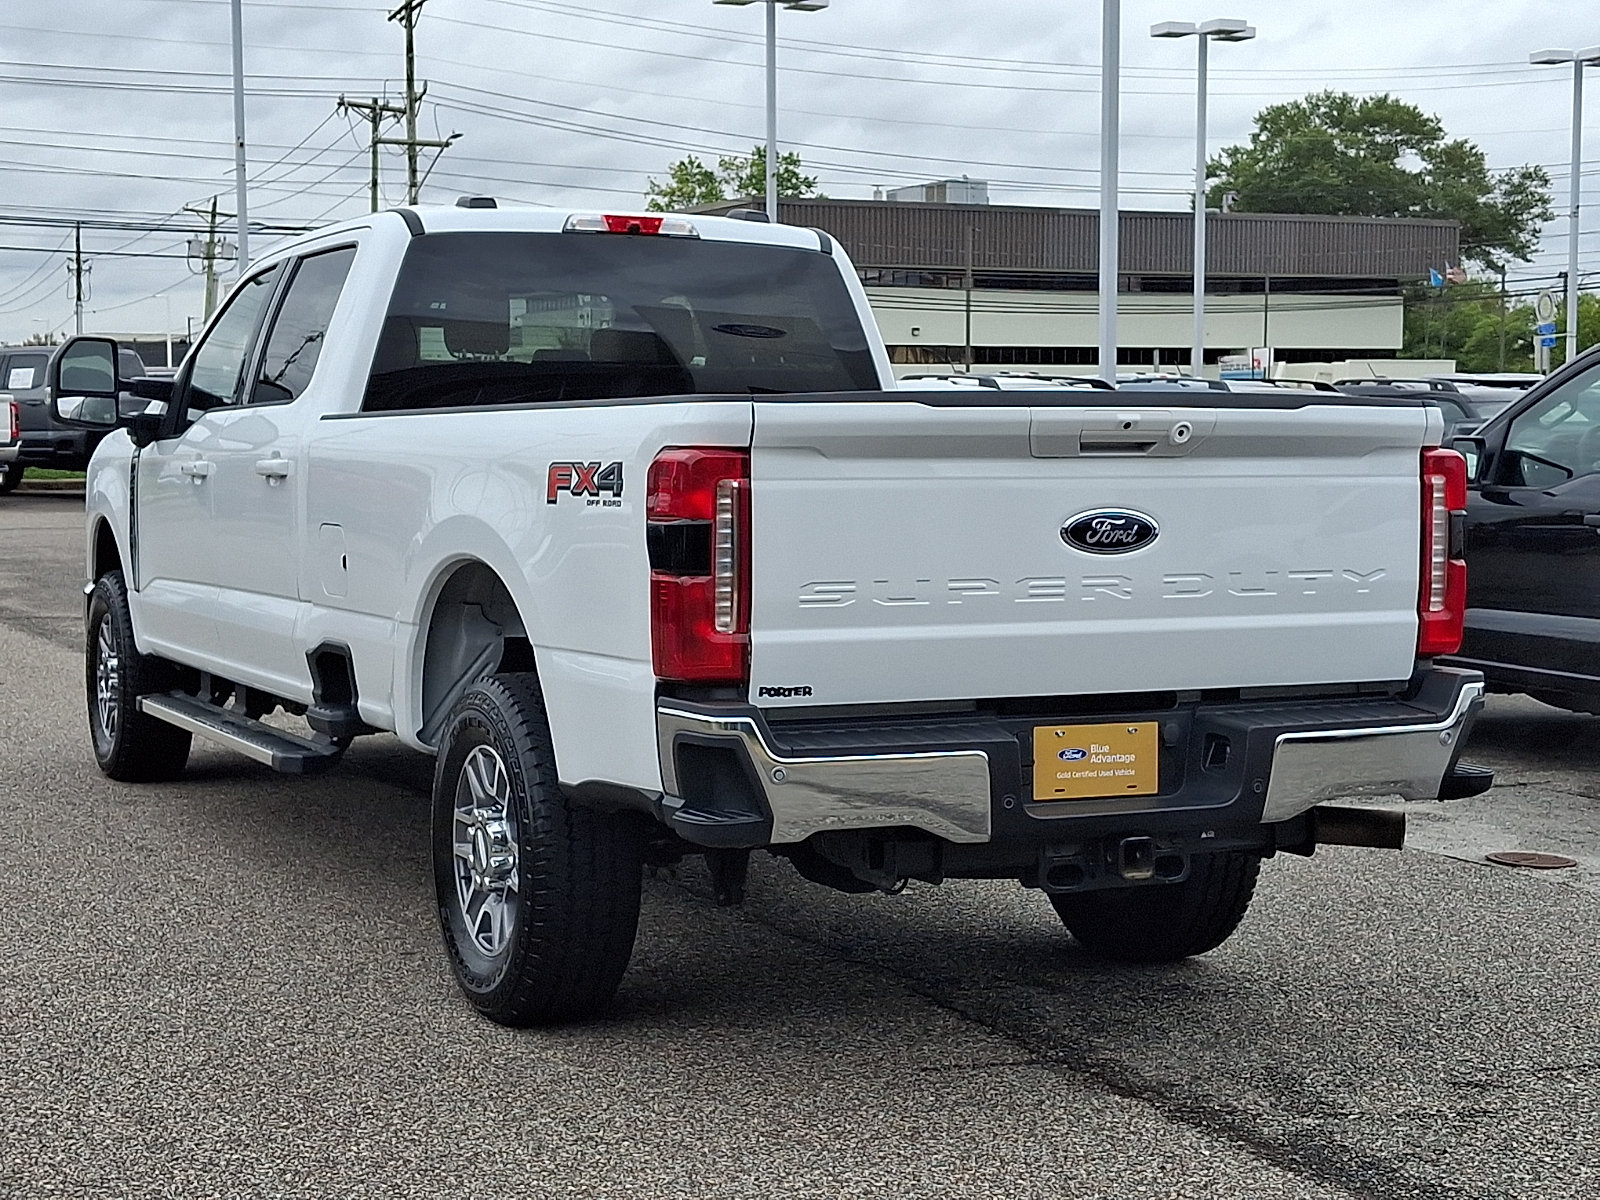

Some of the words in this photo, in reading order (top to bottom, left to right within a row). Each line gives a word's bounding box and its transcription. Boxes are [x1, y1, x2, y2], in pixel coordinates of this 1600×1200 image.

[546, 461, 624, 505] FX4
[586, 499, 600, 507] OFF
[602, 499, 622, 508] ROAD
[1085, 517, 1139, 544] Ford
[798, 574, 1132, 608] SUPER
[1162, 567, 1386, 599] DUTY
[758, 685, 813, 698] PORTER
[1090, 743, 1110, 753] Blue
[1090, 753, 1136, 764] Advantage
[1056, 771, 1072, 779] Gold
[1072, 769, 1097, 778] Certified
[1098, 768, 1114, 777] Used
[1114, 768, 1136, 776] Vehicle
